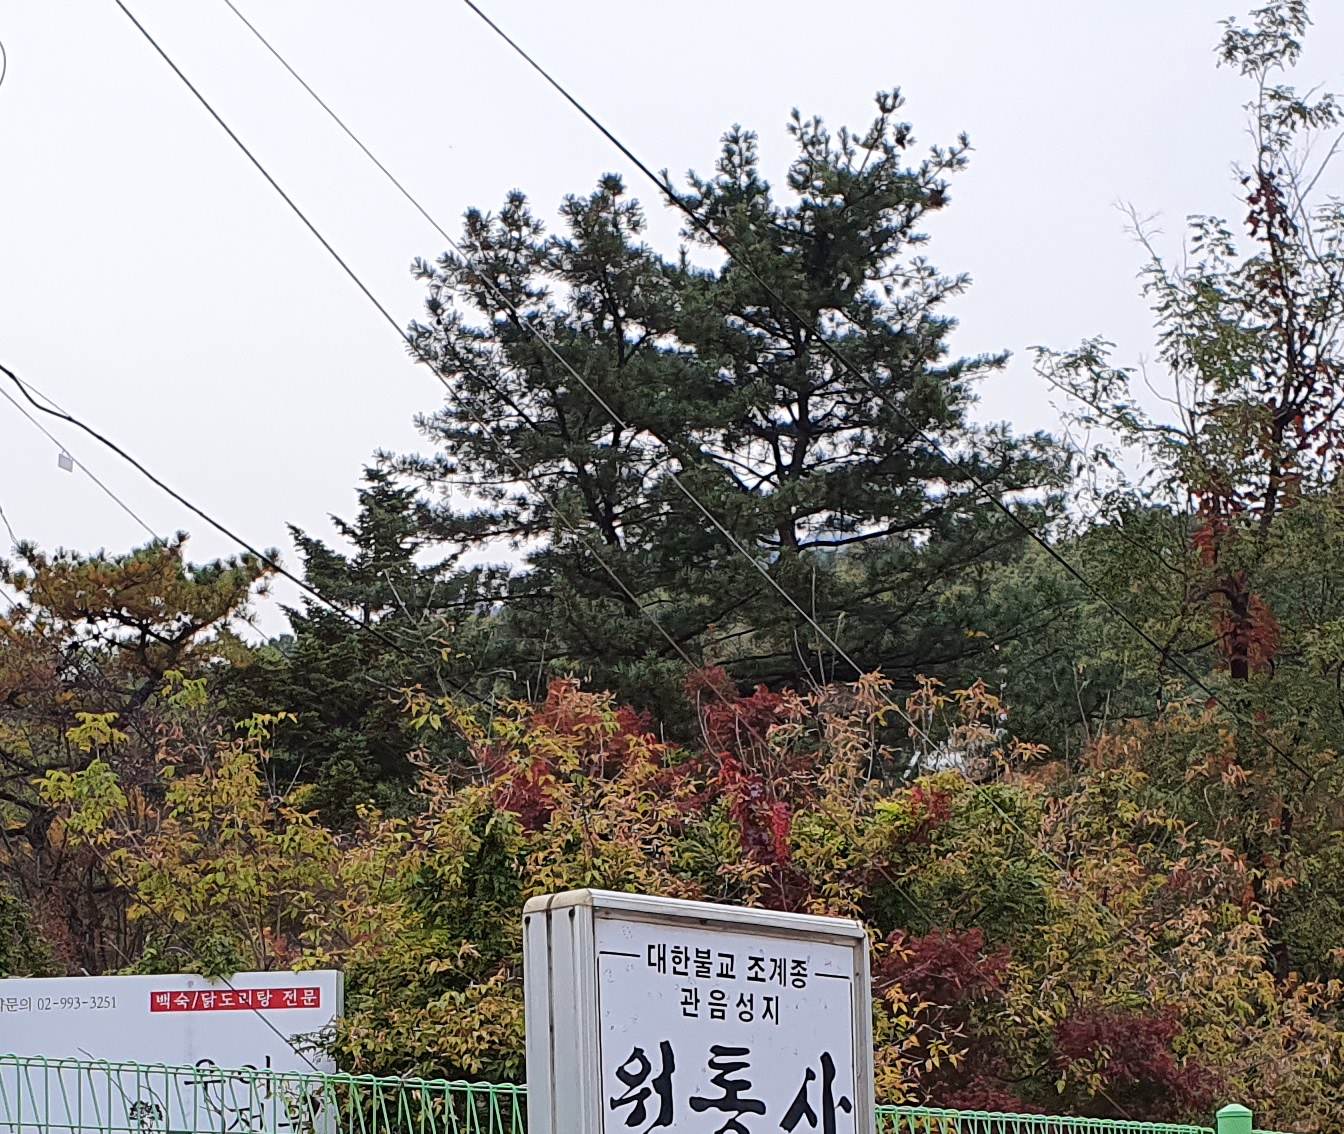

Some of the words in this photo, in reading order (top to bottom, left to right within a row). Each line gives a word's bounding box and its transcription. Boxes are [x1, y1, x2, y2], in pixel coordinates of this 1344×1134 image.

[647, 943, 736, 980] 대한불교
[746, 954, 809, 989] 조계종
[37, 996, 117, 1011] 02-993-3251
[156, 990, 273, 1009] 백숙/닭도리탕
[282, 989, 318, 1007] 전문
[680, 987, 780, 1026] 관음성지
